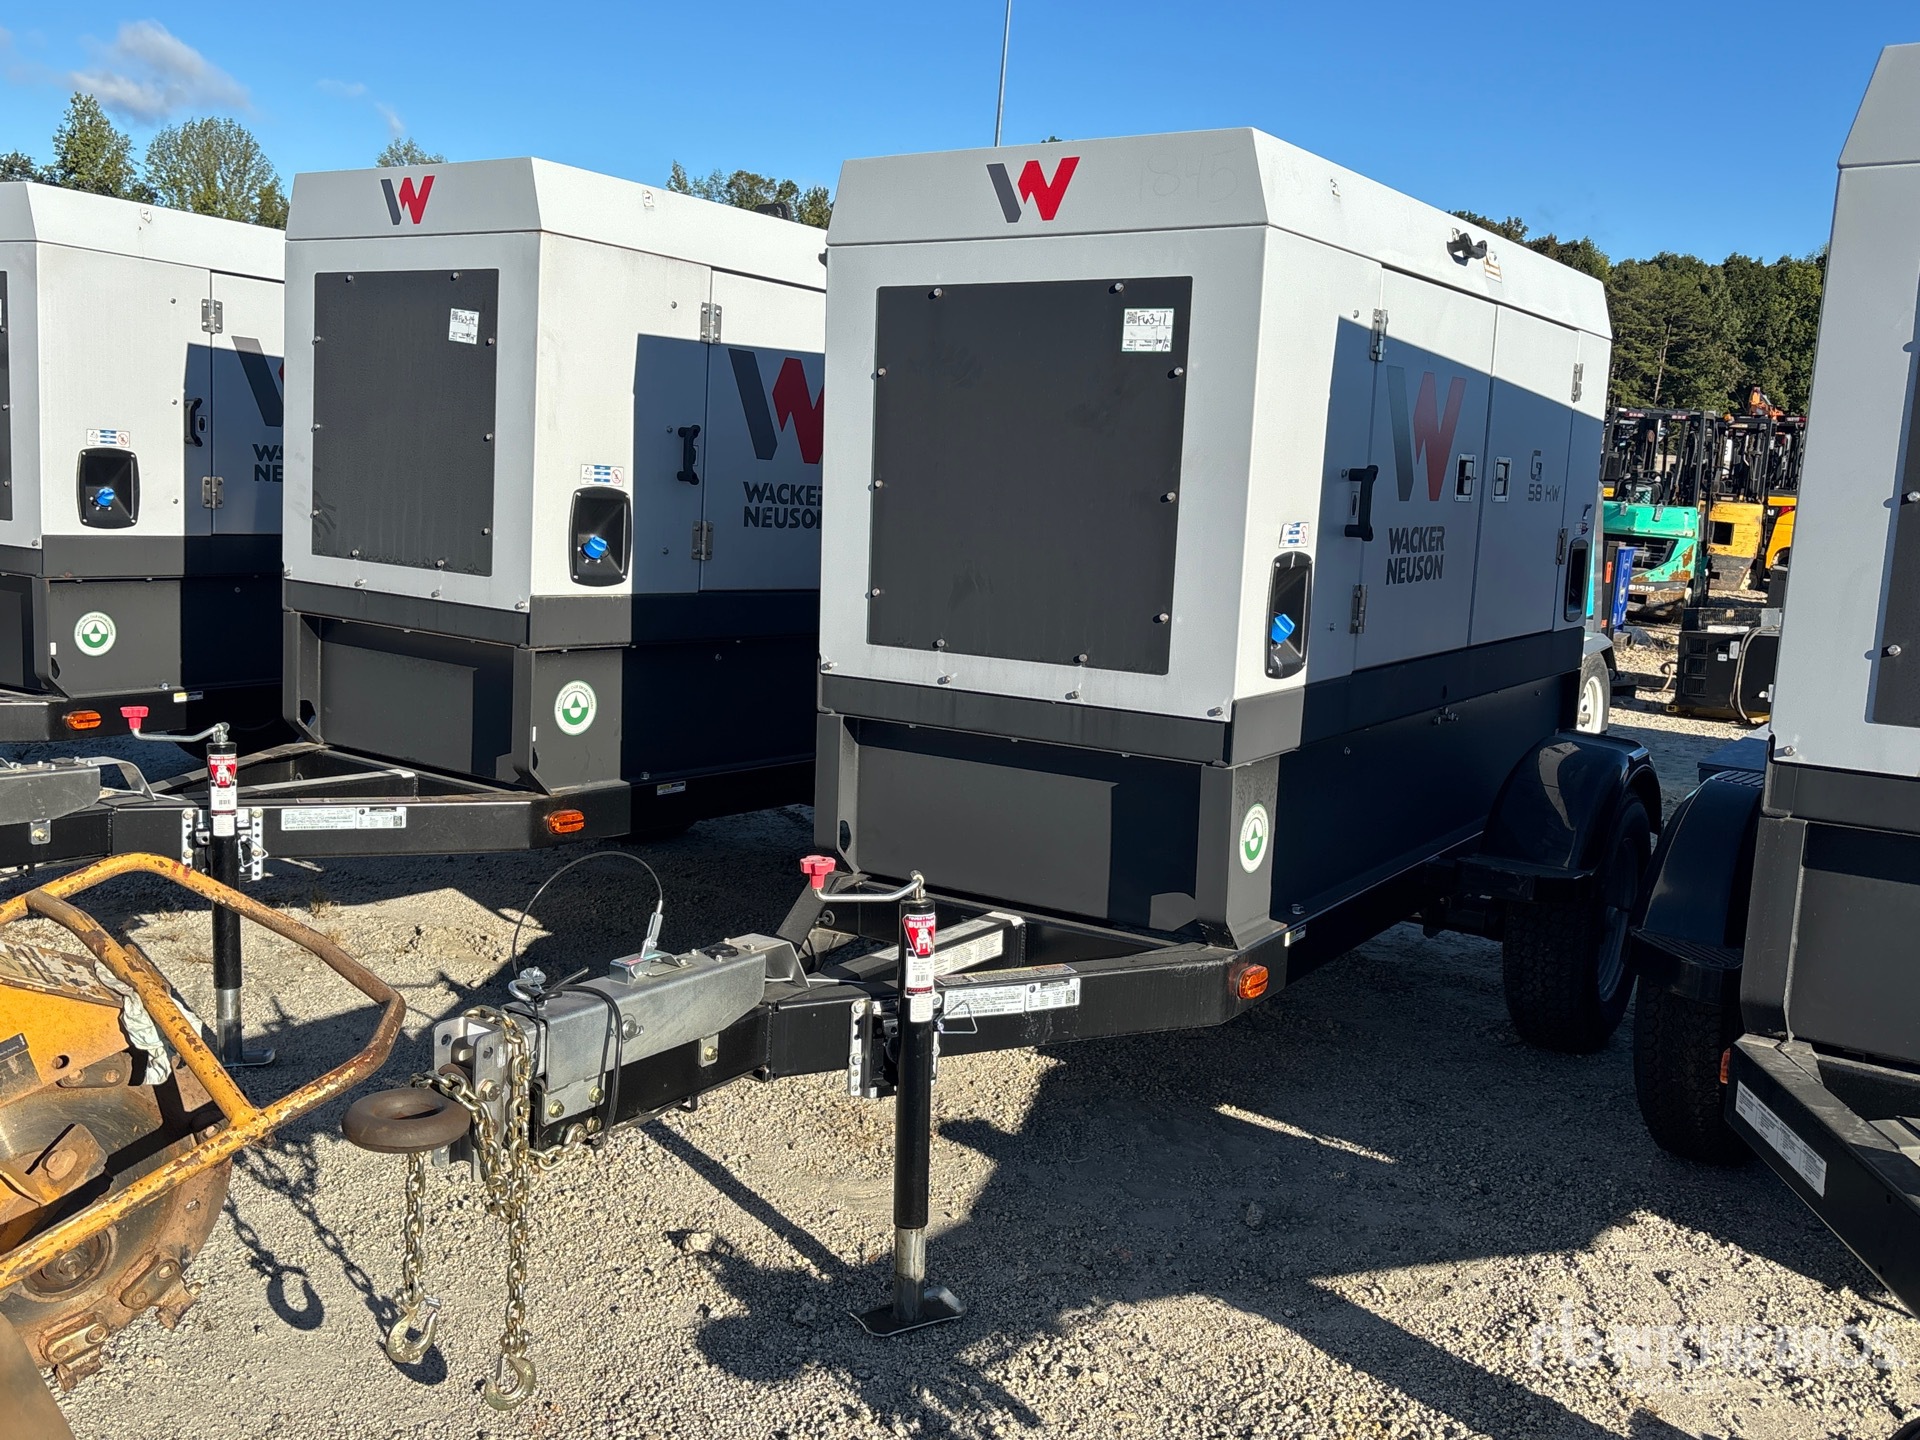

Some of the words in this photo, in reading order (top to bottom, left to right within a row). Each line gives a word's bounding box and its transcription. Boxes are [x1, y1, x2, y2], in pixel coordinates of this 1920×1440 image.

[1527, 483, 1543, 502] 58
[1388, 525, 1446, 555] WACKER
[1385, 554, 1445, 586] NEUSON
[908, 920, 935, 928] BULLDO
